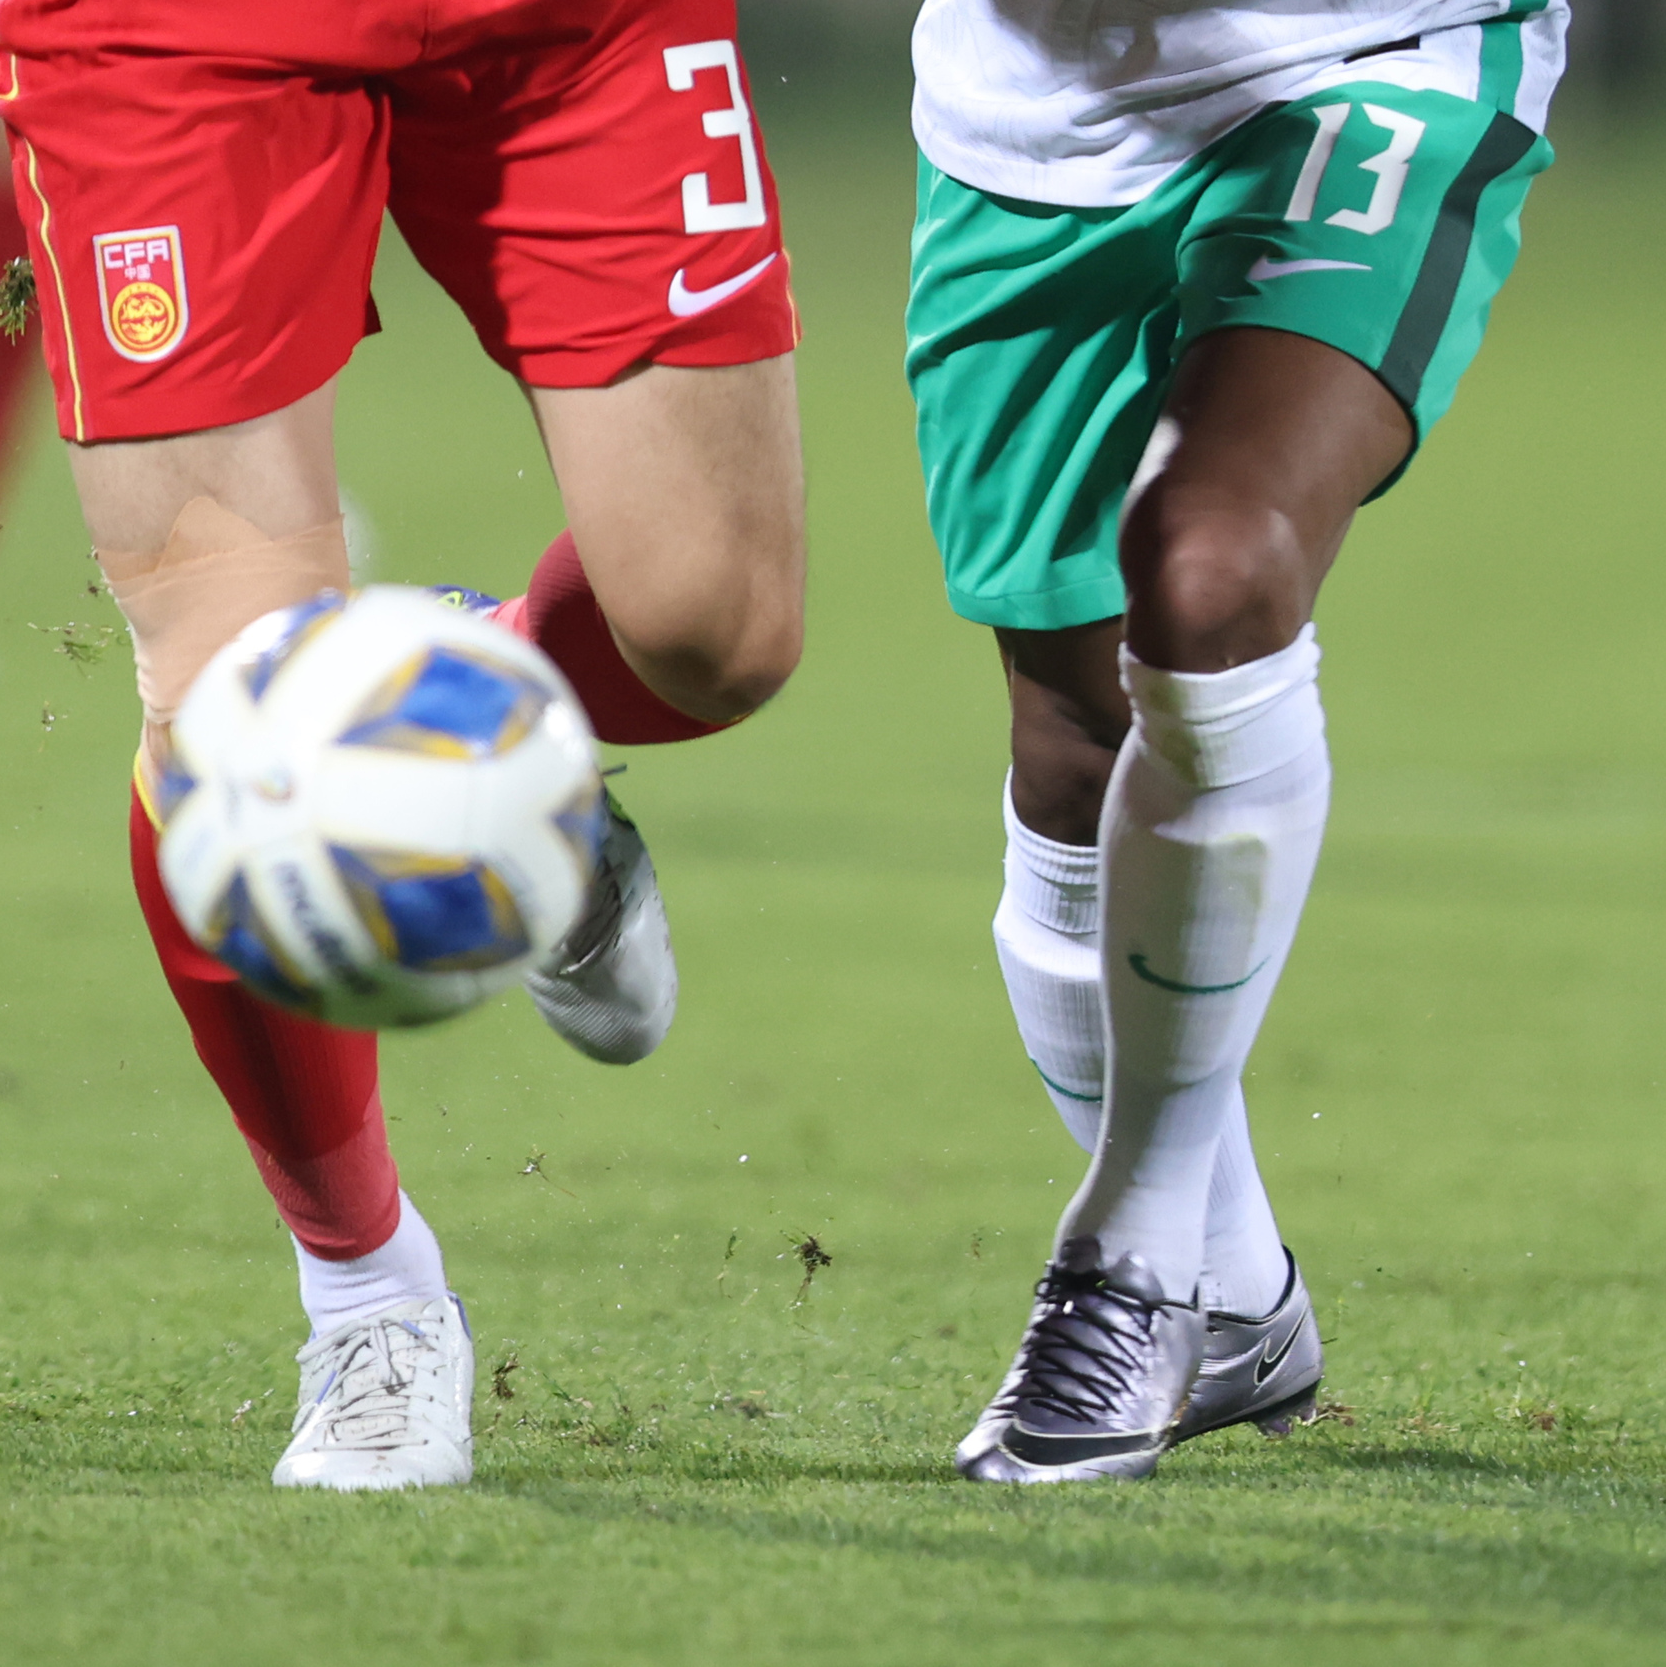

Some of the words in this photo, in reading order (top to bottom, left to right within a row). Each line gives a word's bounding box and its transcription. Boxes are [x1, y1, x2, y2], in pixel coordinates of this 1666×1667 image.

[662, 39, 767, 235] 3
[1283, 102, 1427, 236] 13
[103, 238, 170, 270] CFA
